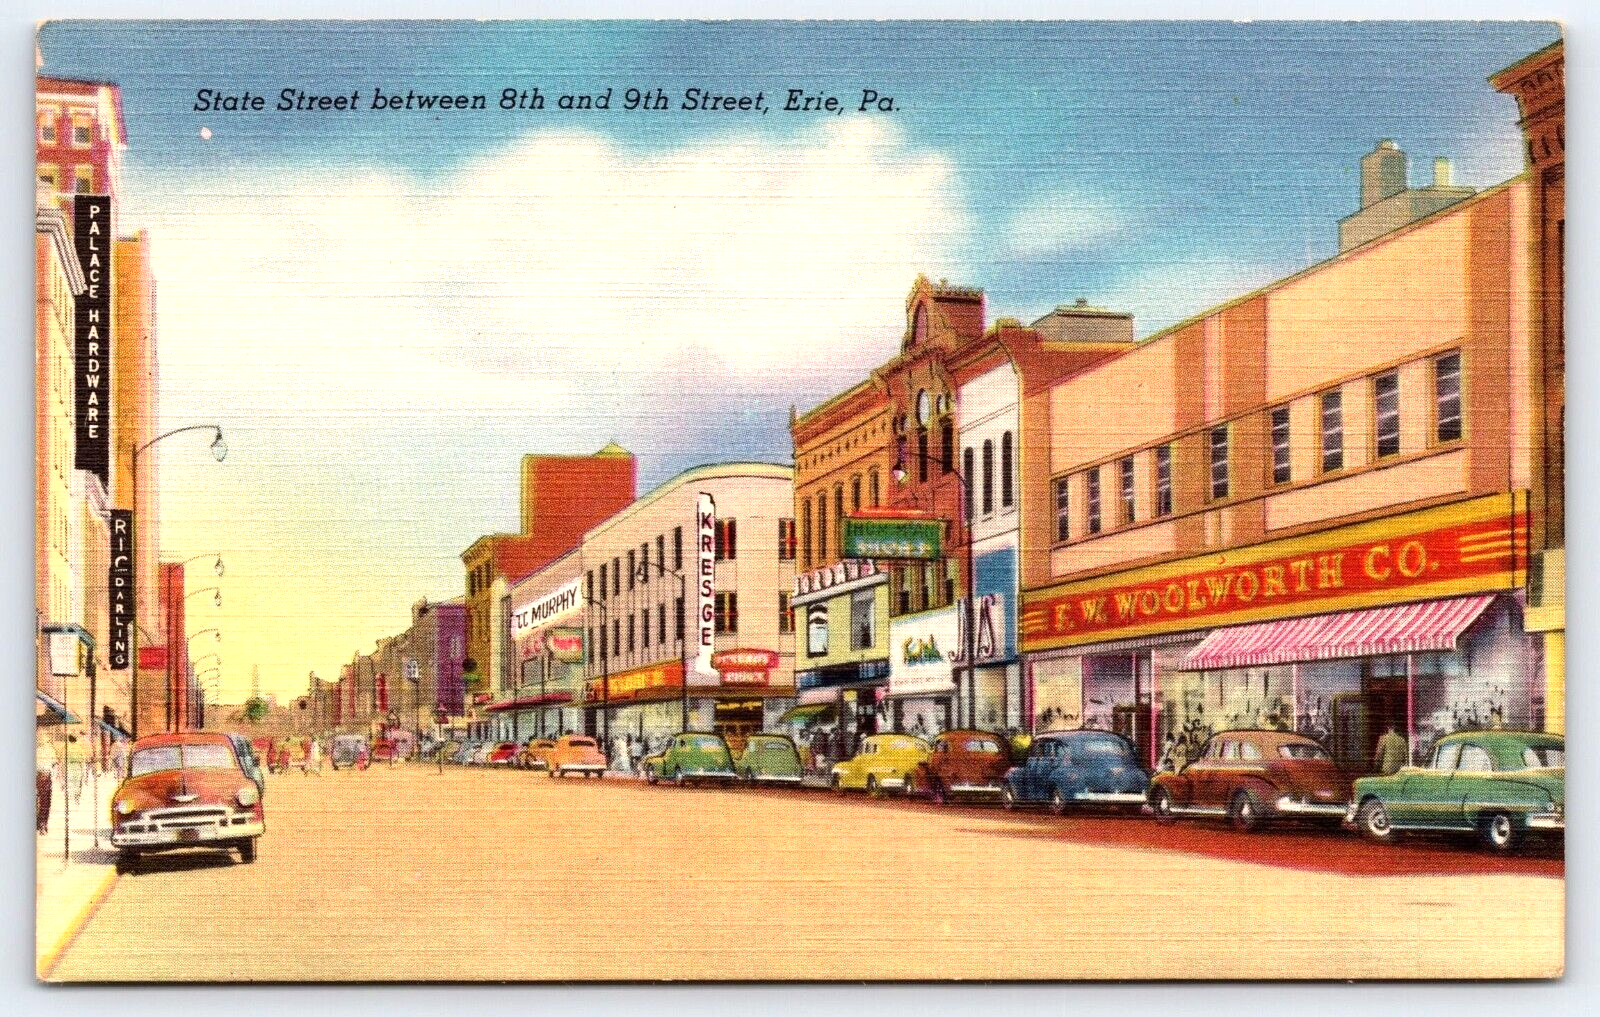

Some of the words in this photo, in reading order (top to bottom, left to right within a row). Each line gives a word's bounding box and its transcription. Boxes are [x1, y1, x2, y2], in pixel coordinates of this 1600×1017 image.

[88, 205, 101, 299] PALACE
[86, 309, 100, 438] HARDWARE
[115, 577, 126, 665] DARLING
[531, 585, 577, 624] MURPHY
[701, 512, 713, 646] KRESGE
[1113, 552, 1345, 619] WOOLWORTH
[1364, 540, 1440, 581] CO.
